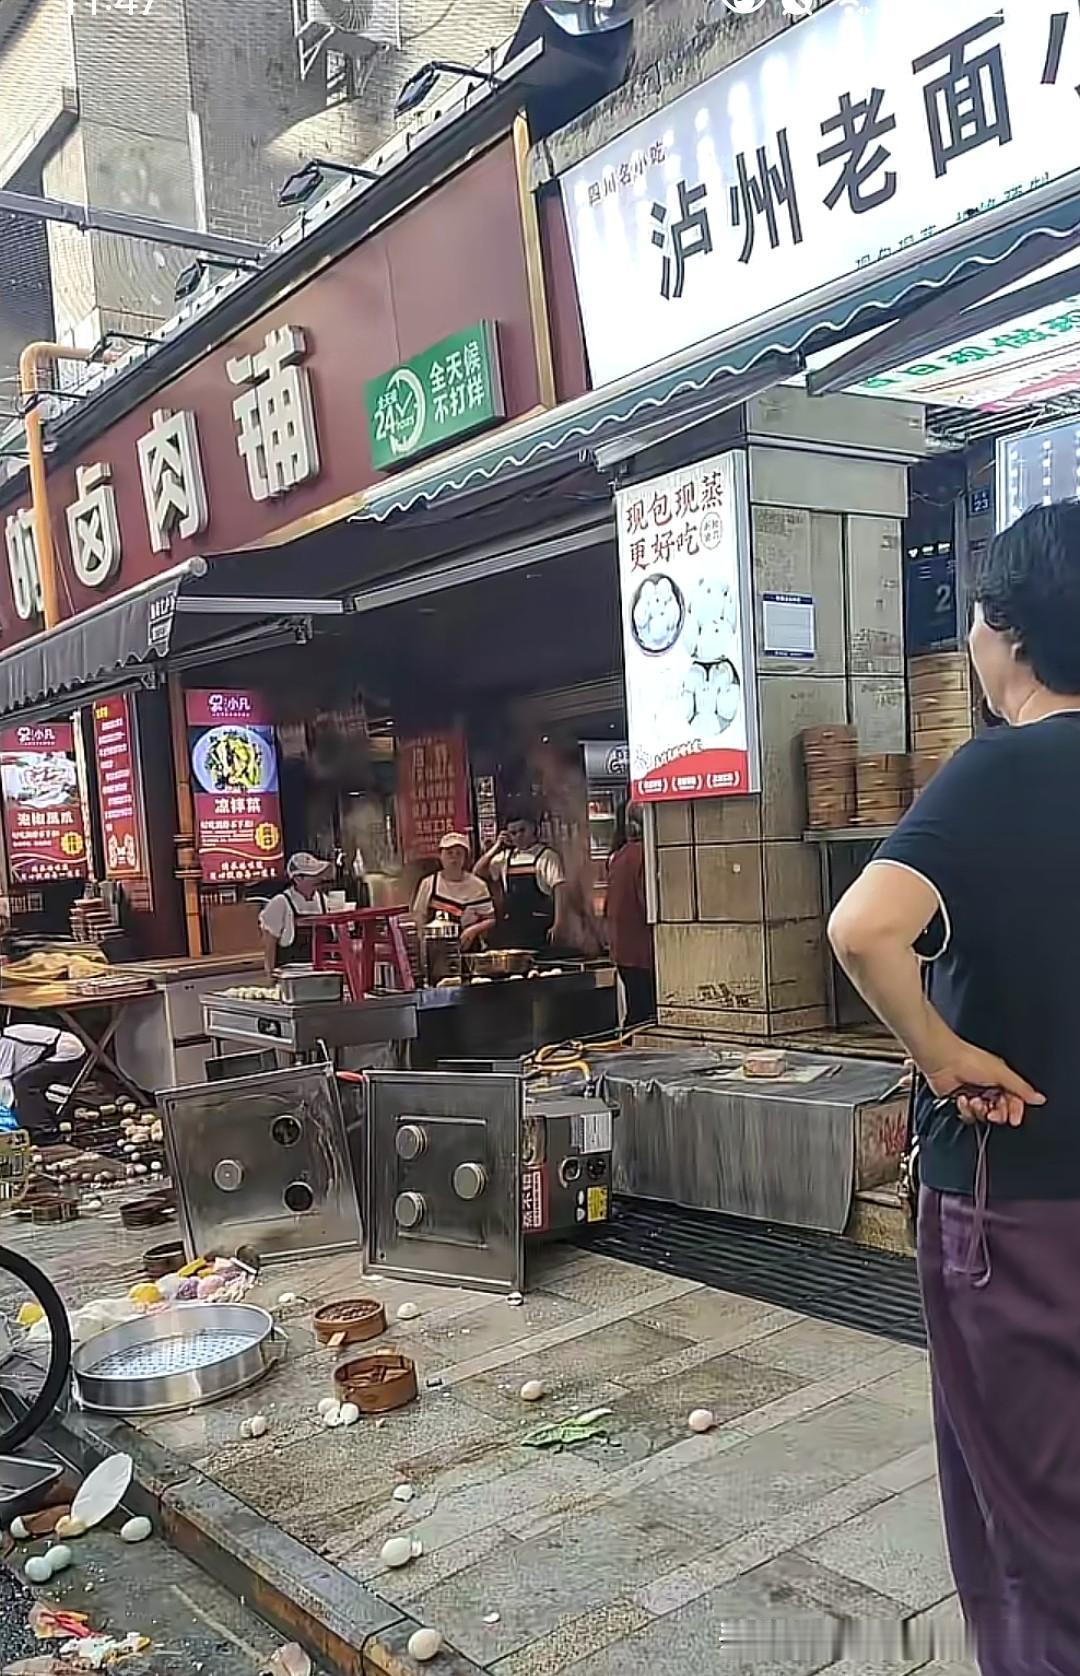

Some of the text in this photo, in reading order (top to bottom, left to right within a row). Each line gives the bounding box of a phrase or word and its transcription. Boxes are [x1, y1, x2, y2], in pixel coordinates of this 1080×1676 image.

[588, 140, 666, 206] 四川名小吃
[429, 340, 482, 394] 全天候
[374, 404, 395, 440] 24
[432, 373, 485, 424] 不打烊
[626, 471, 723, 534] 现包现蒸
[630, 521, 700, 573] 更好吃
